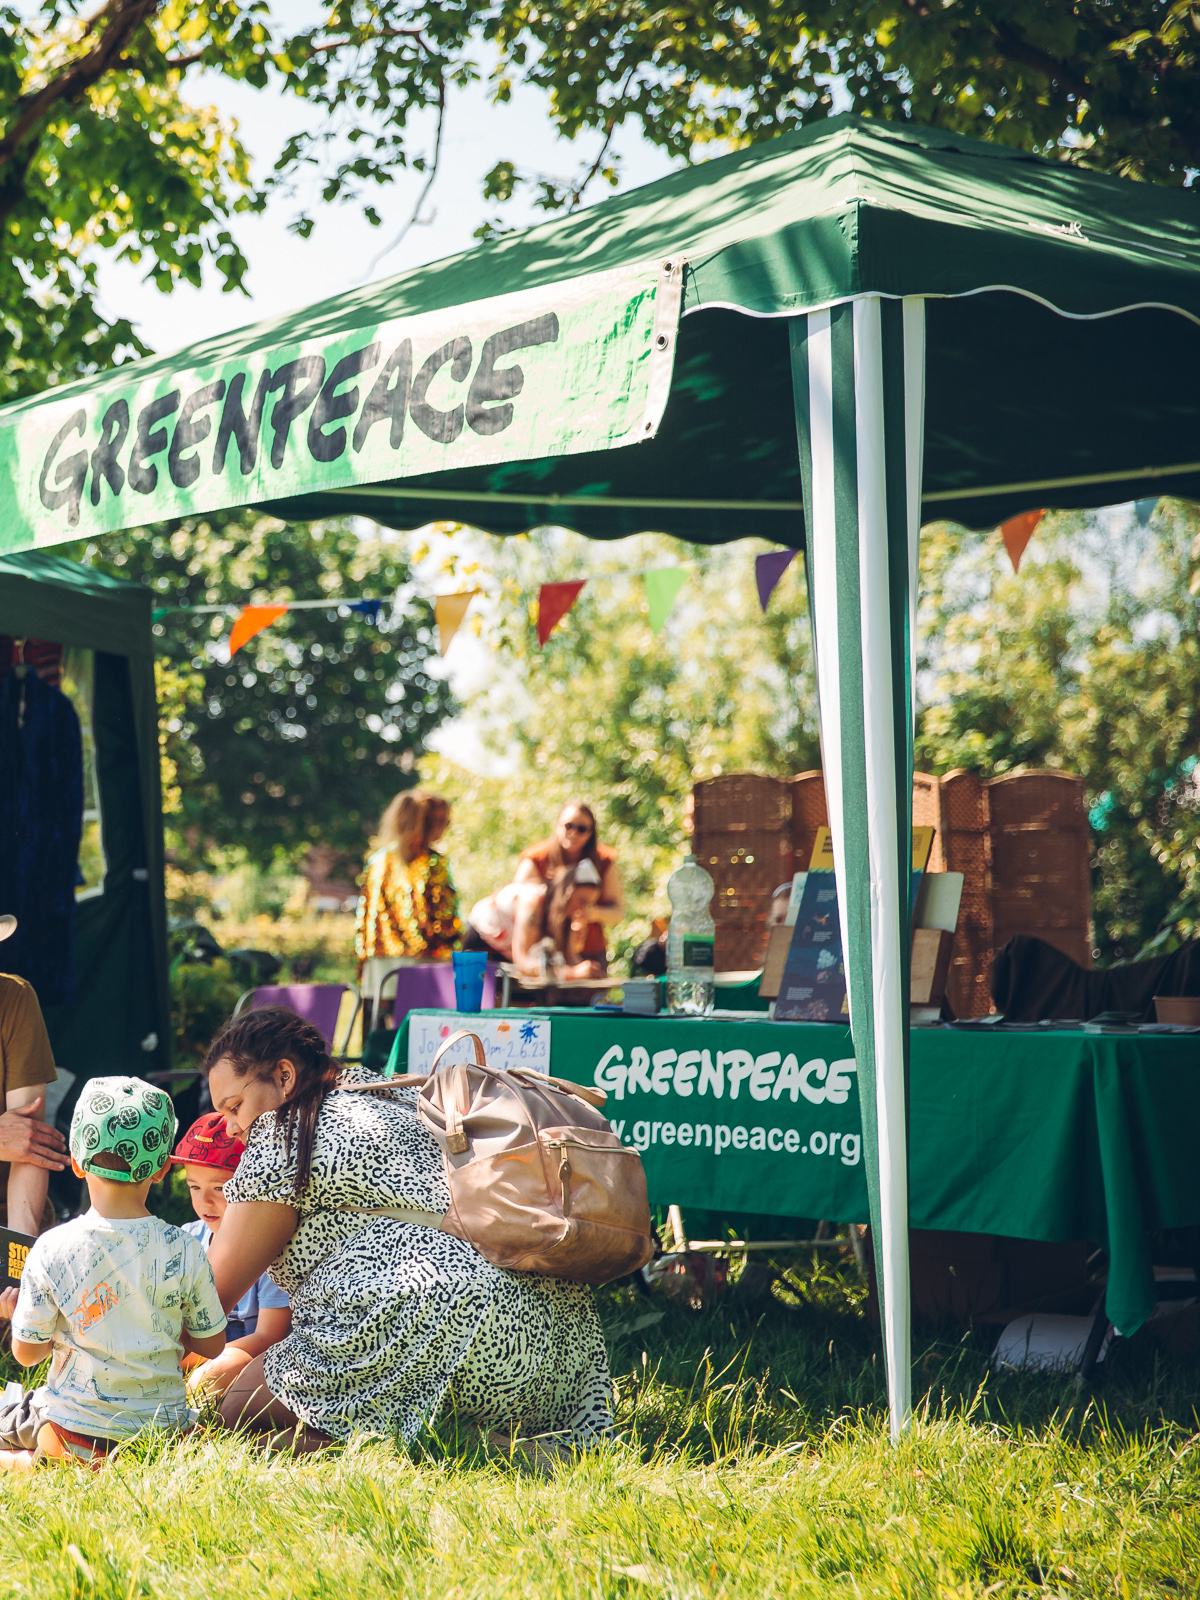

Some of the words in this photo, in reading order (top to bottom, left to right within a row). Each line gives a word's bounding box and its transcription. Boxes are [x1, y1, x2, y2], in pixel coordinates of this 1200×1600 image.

[38, 311, 560, 527] GREENPEACE
[594, 1044, 858, 1104] GREENPEACE
[8, 1241, 31, 1261] STO
